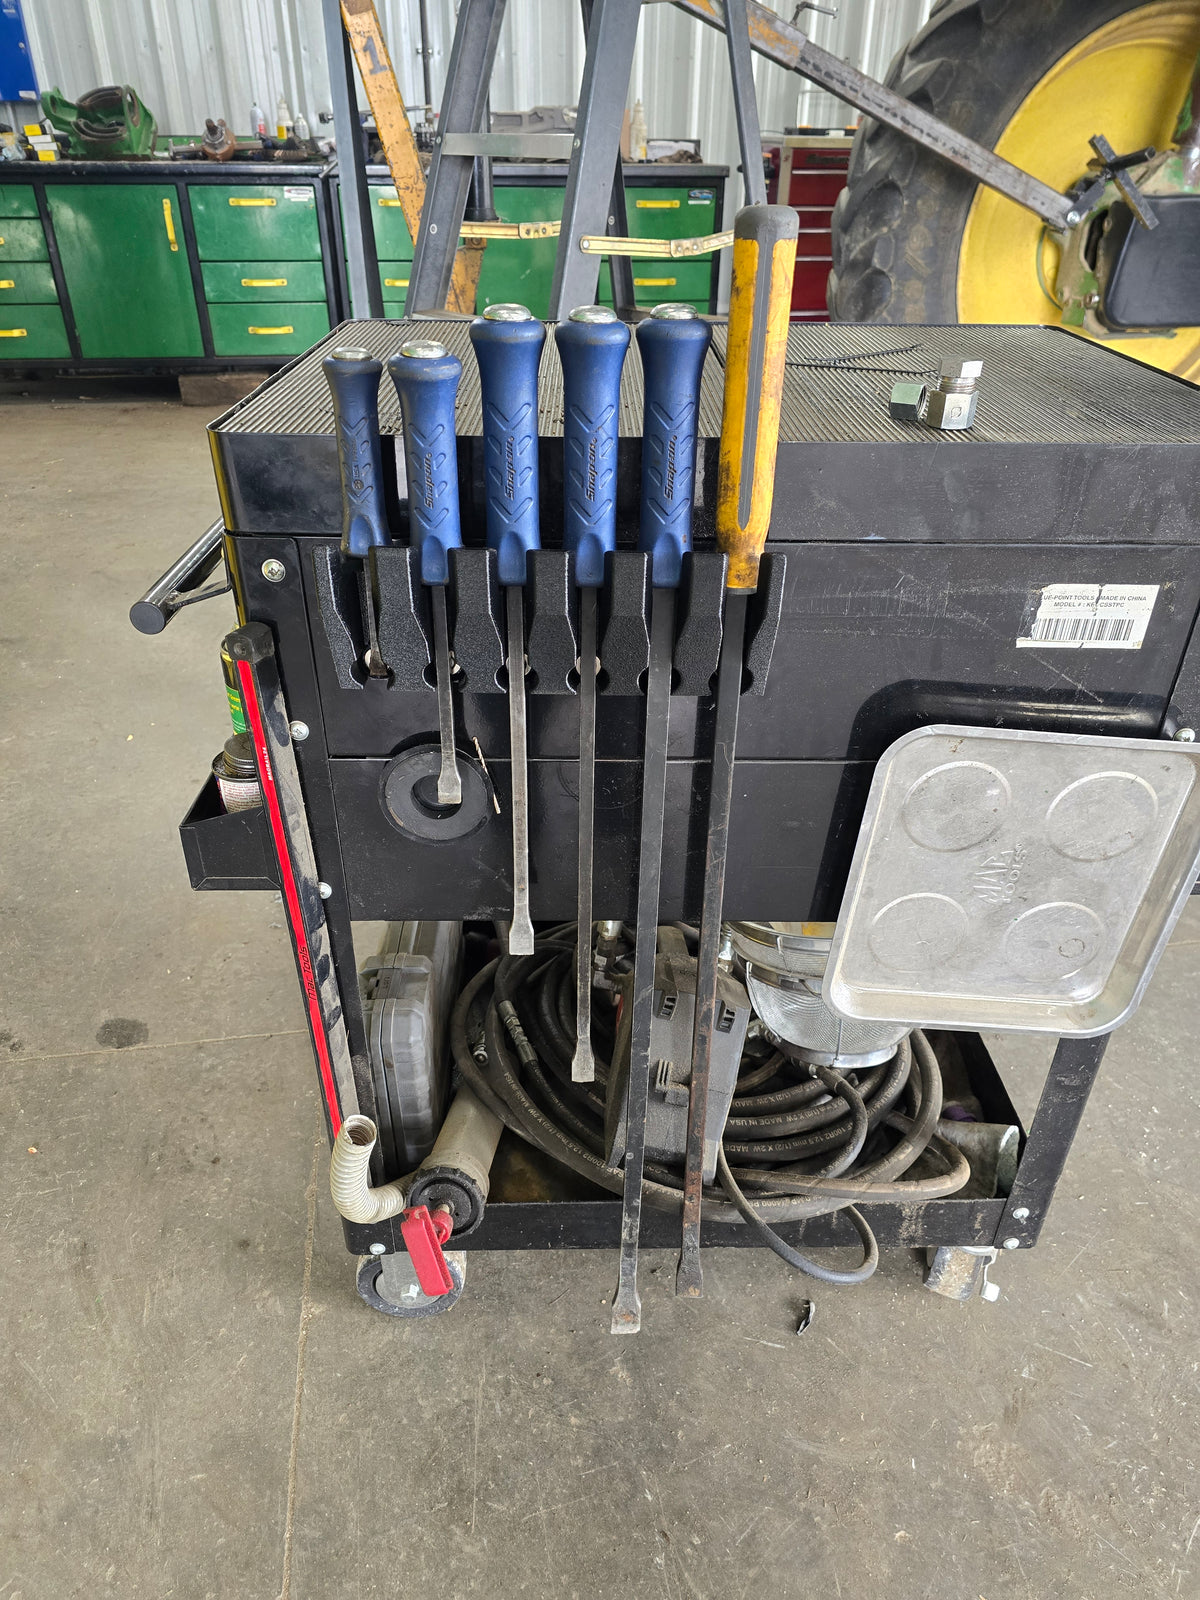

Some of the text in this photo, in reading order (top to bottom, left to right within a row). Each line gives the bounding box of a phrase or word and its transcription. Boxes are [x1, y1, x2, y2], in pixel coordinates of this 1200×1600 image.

[363, 35, 388, 75] 1
[760, 1116, 783, 1126] MADE
[724, 1143, 749, 1152] MADE
[752, 1144, 767, 1152] 2W
[767, 1144, 774, 1152] X
